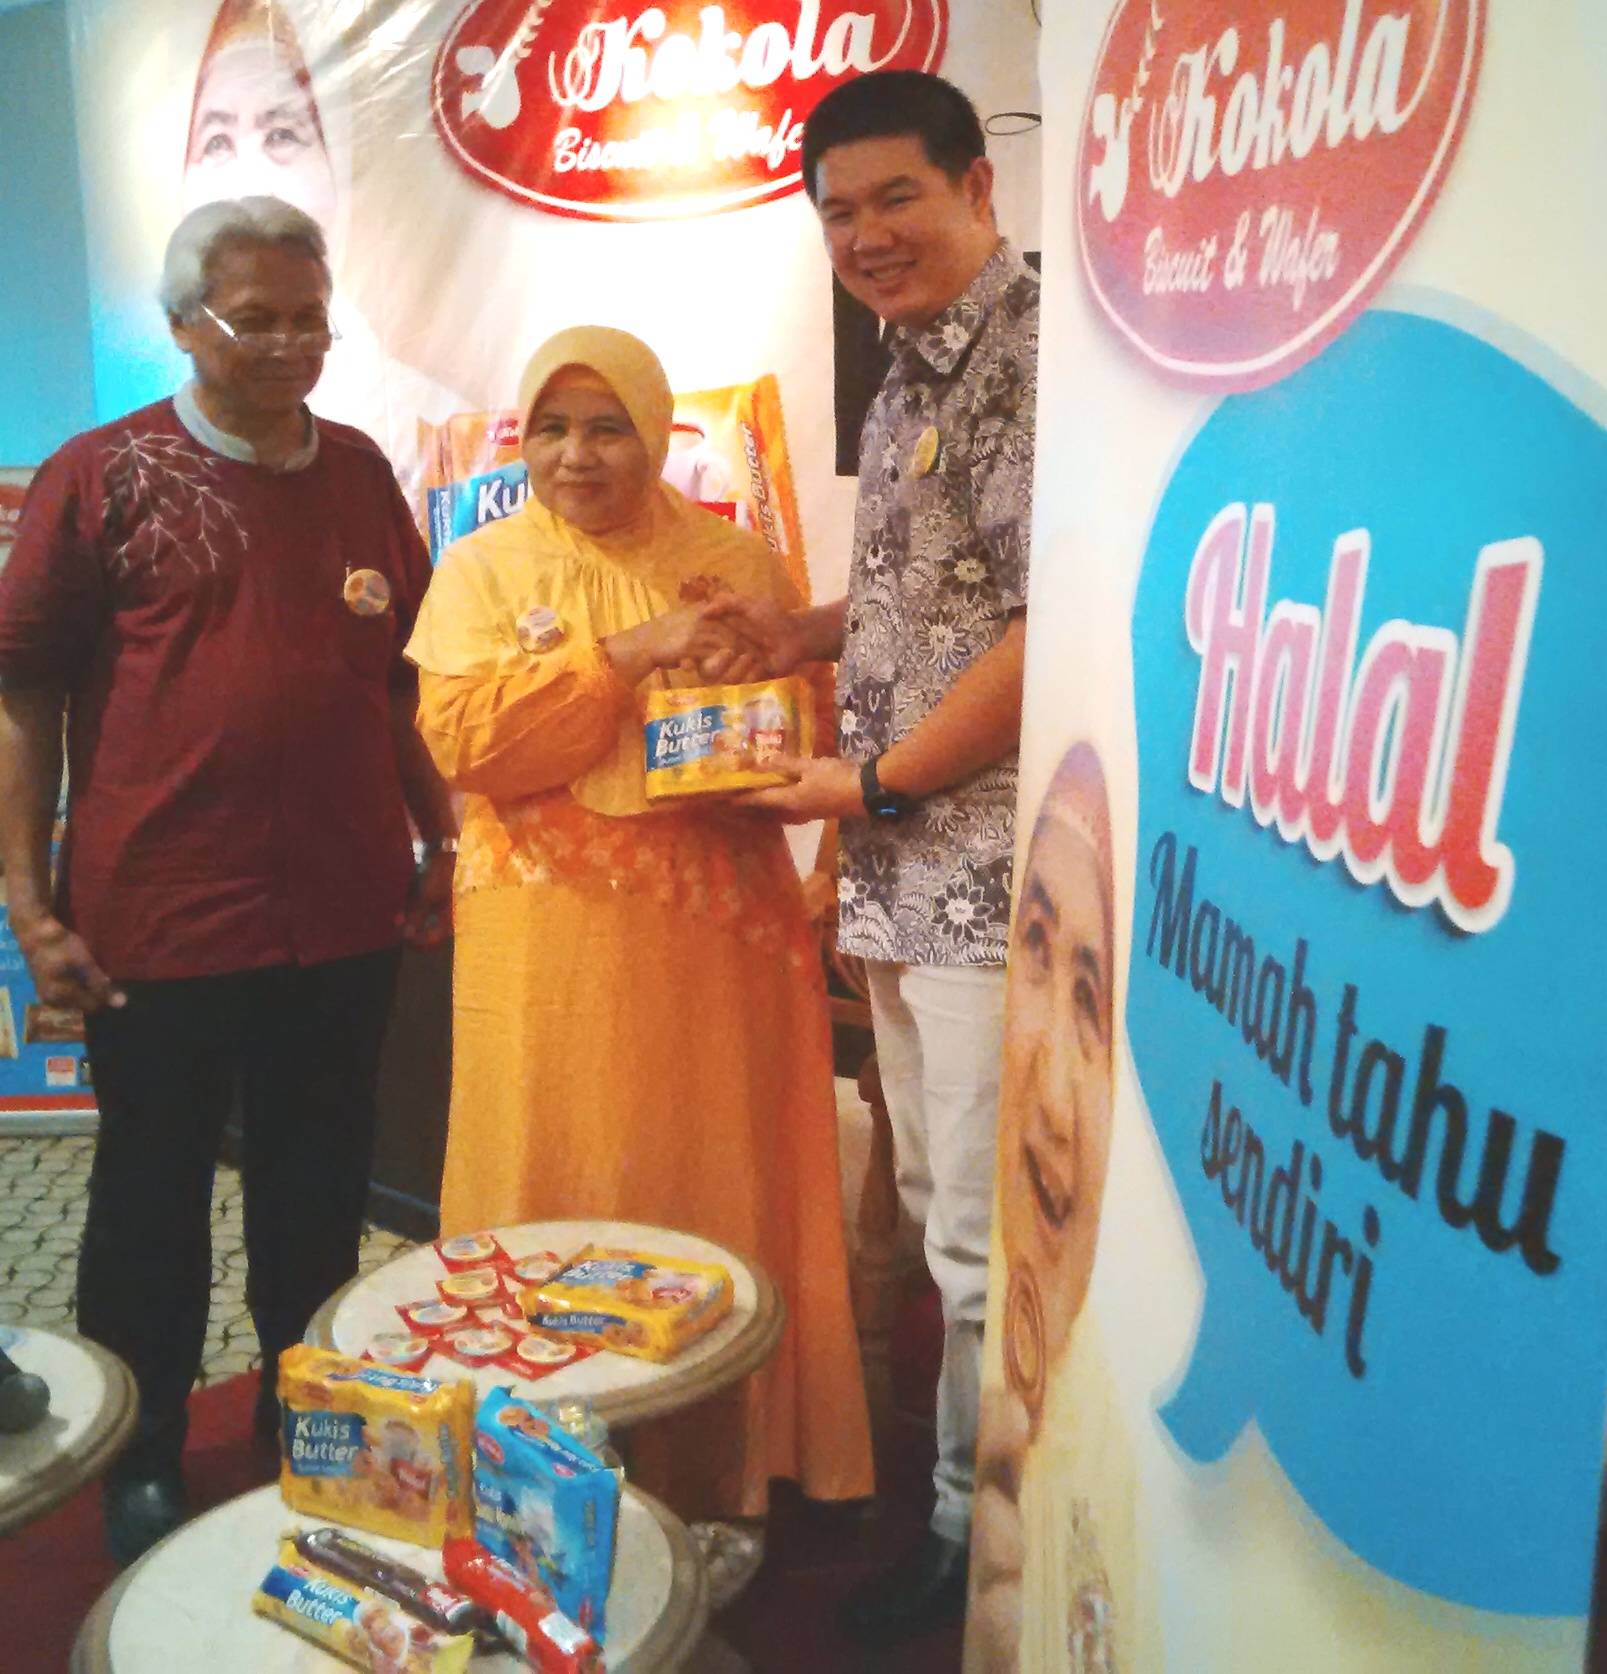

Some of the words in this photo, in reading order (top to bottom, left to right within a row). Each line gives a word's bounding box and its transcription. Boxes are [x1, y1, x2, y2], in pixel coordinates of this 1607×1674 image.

[708, 108, 804, 169] Wafe
[1149, 0, 1415, 198] Kokola
[1224, 210, 1250, 290] &
[1259, 204, 1340, 312] Wafer
[660, 711, 713, 741] Kukis
[1186, 501, 1544, 933] Halal
[1147, 831, 1317, 1107] Mamah
[1327, 983, 1566, 1276] tahu
[1201, 1079, 1381, 1379] sendiri
[292, 1437, 360, 1462] Butter
[295, 1414, 350, 1441] Kukis
[286, 1589, 343, 1626] Butter
